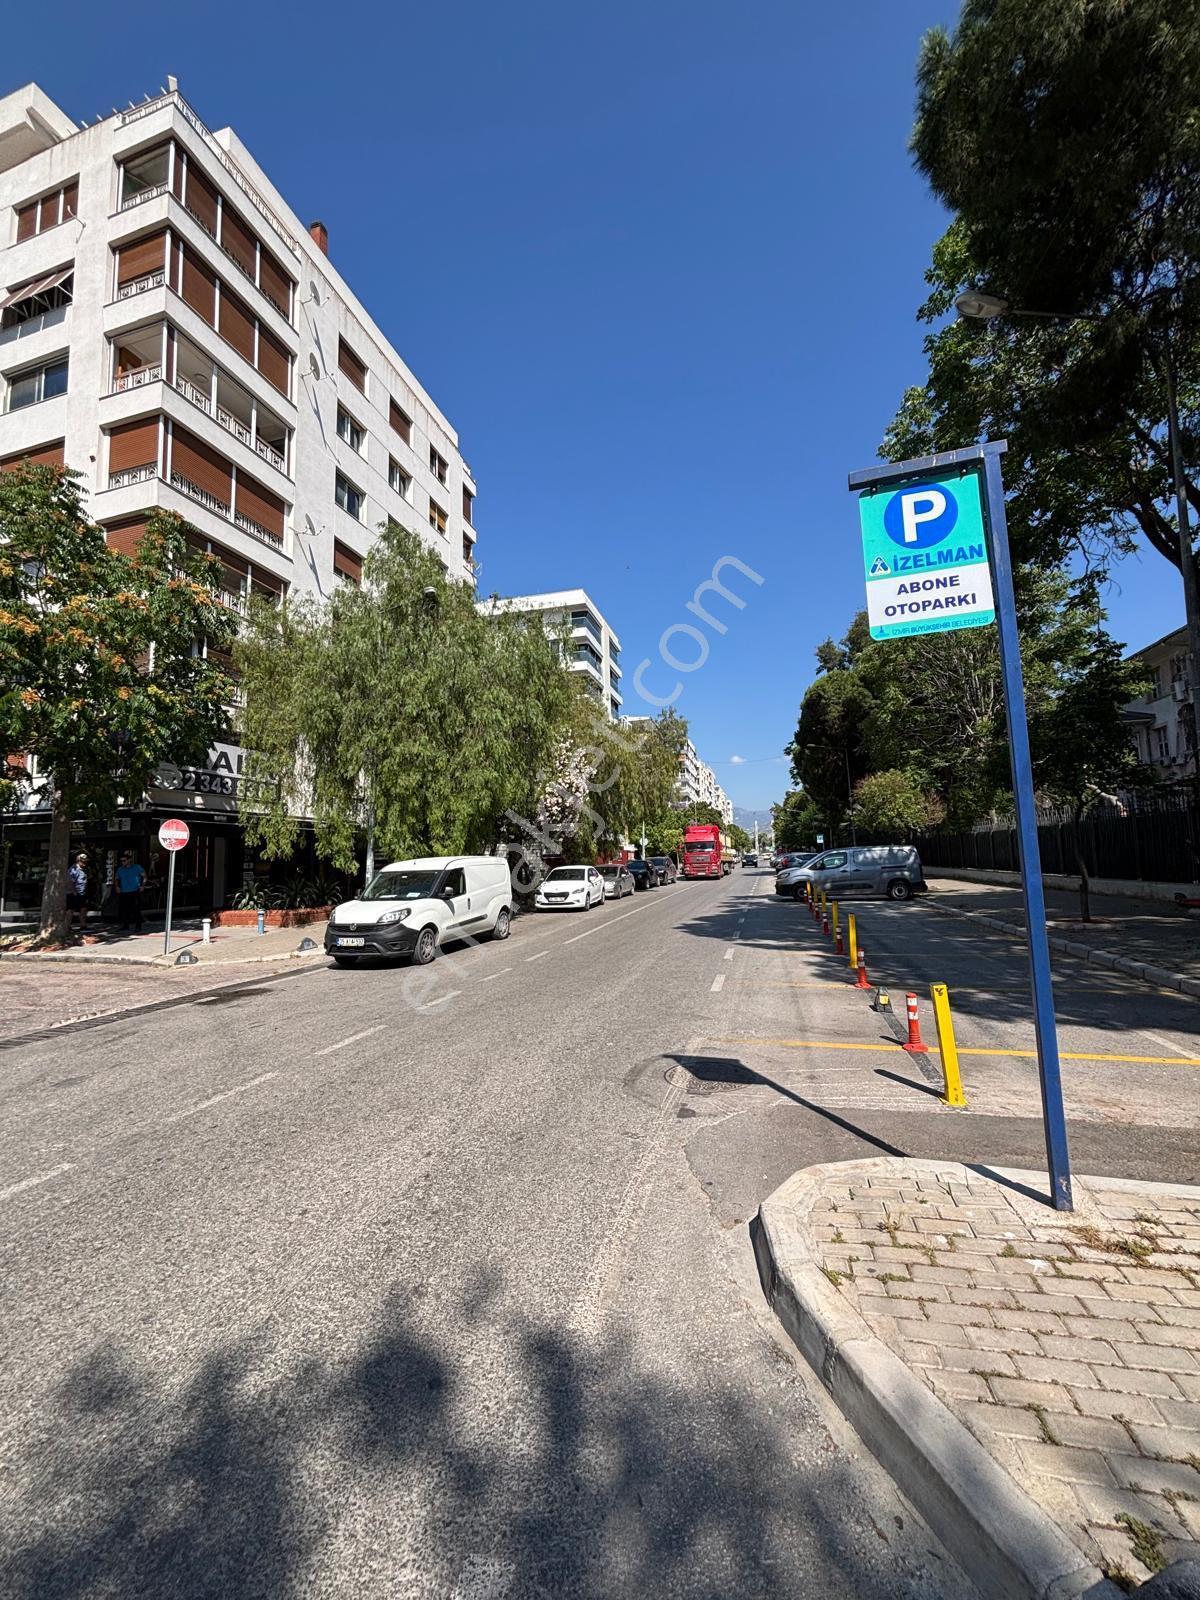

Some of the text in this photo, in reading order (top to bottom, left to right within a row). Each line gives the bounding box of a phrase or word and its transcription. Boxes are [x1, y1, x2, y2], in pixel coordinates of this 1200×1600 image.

[901, 490, 947, 543] P
[893, 544, 984, 572] İZELMAN
[897, 575, 960, 595] ABONE
[884, 593, 977, 617] OTOPARKI
[200, 774, 232, 795] 343
